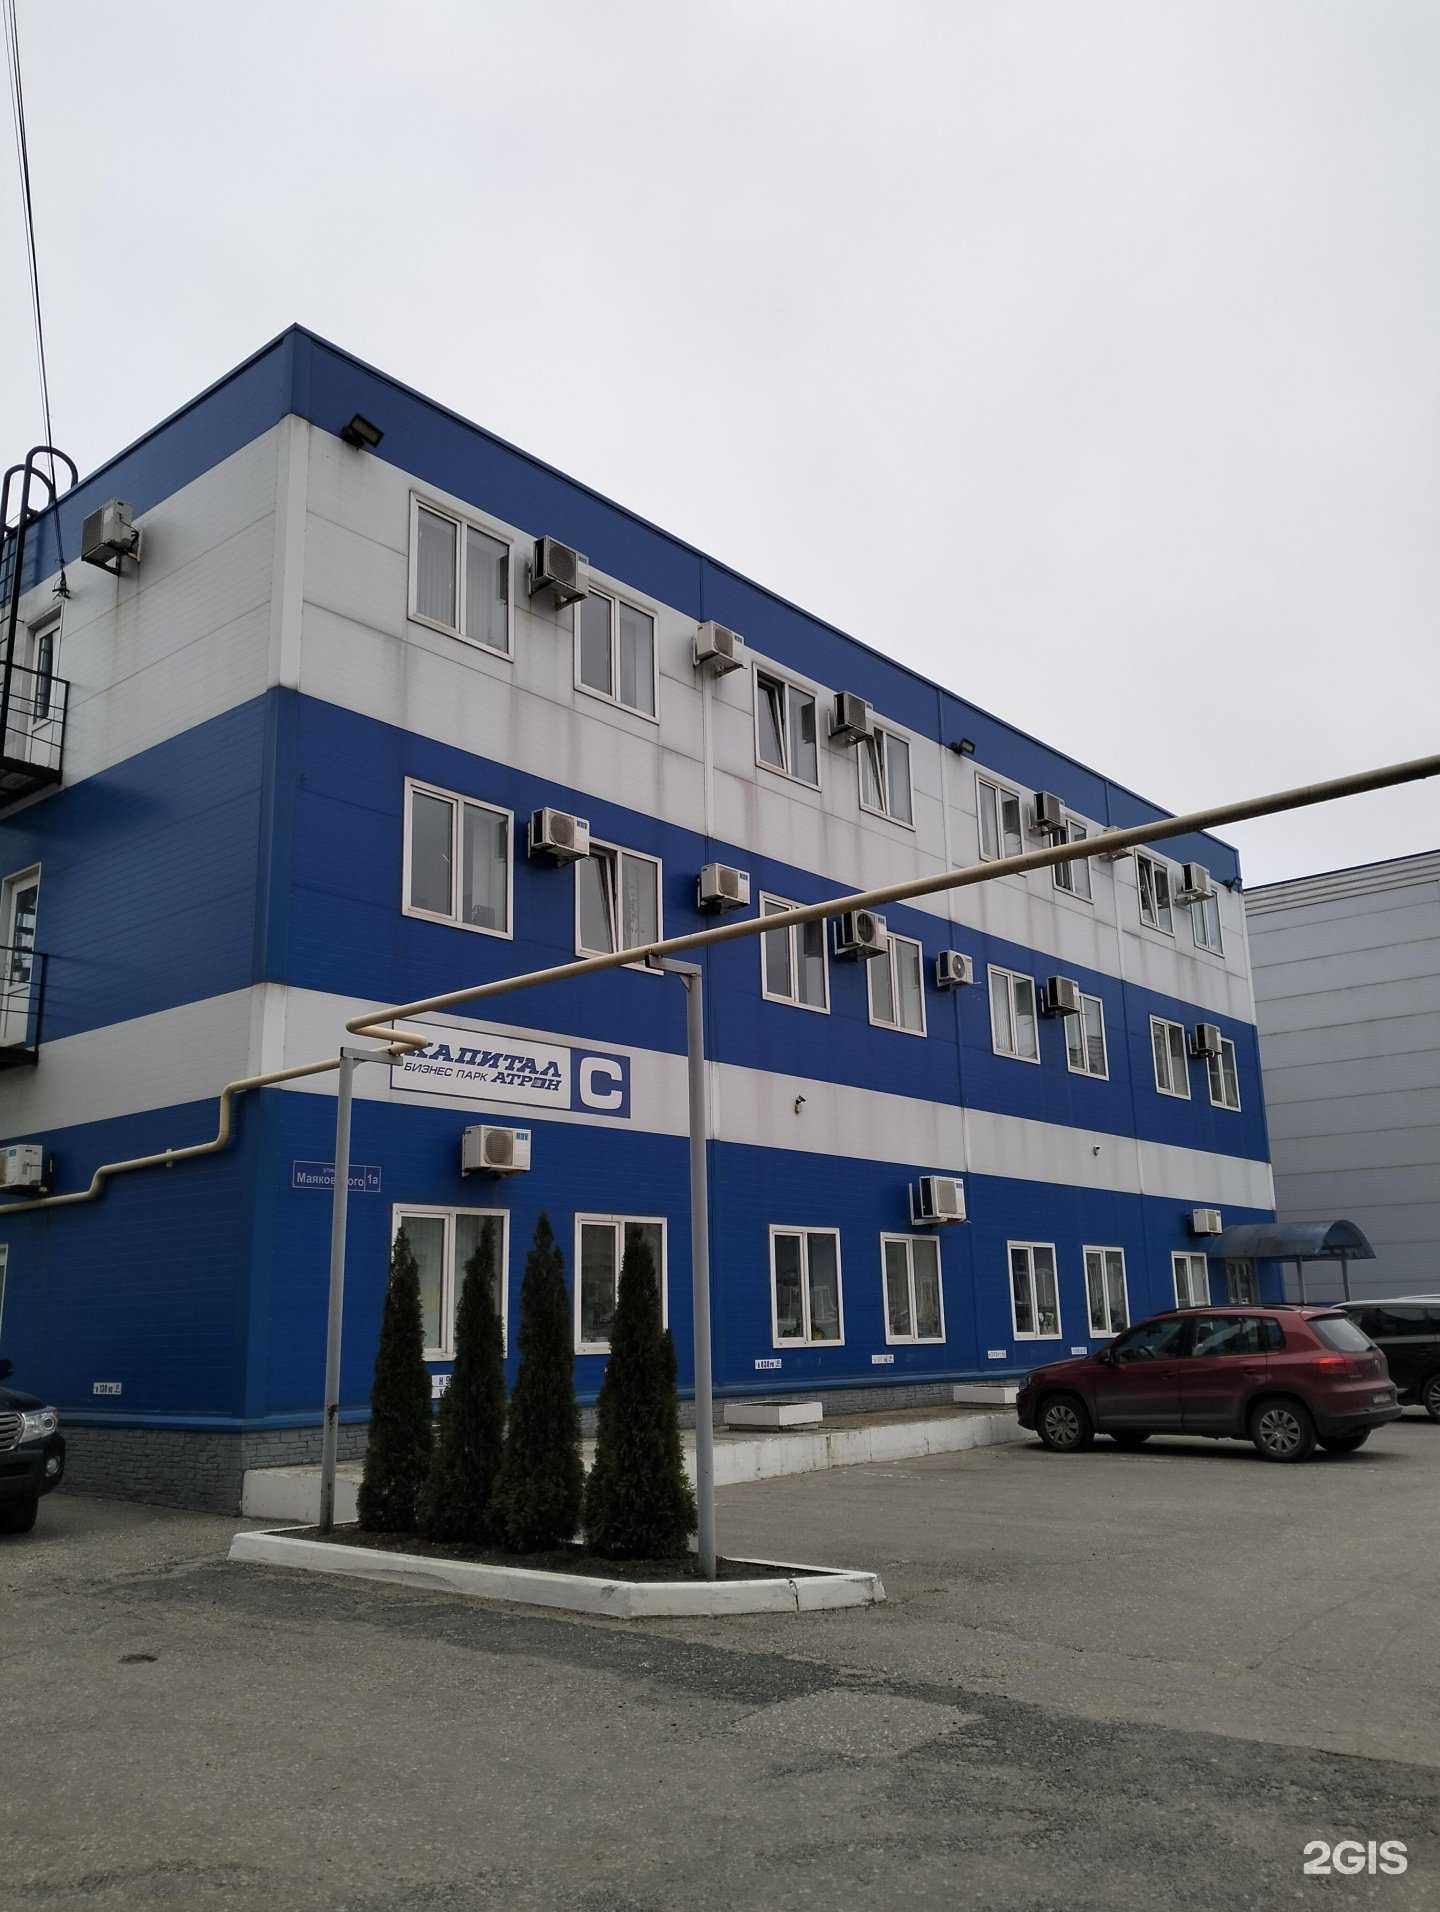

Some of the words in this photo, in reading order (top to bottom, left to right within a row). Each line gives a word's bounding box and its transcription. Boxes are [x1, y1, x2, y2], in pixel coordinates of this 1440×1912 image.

[404, 1062, 453, 1077] БИЗНЕС
[456, 1069, 488, 1082] ПАРК
[491, 1072, 562, 1091] АТРОН
[297, 1172, 364, 1187] Маякового
